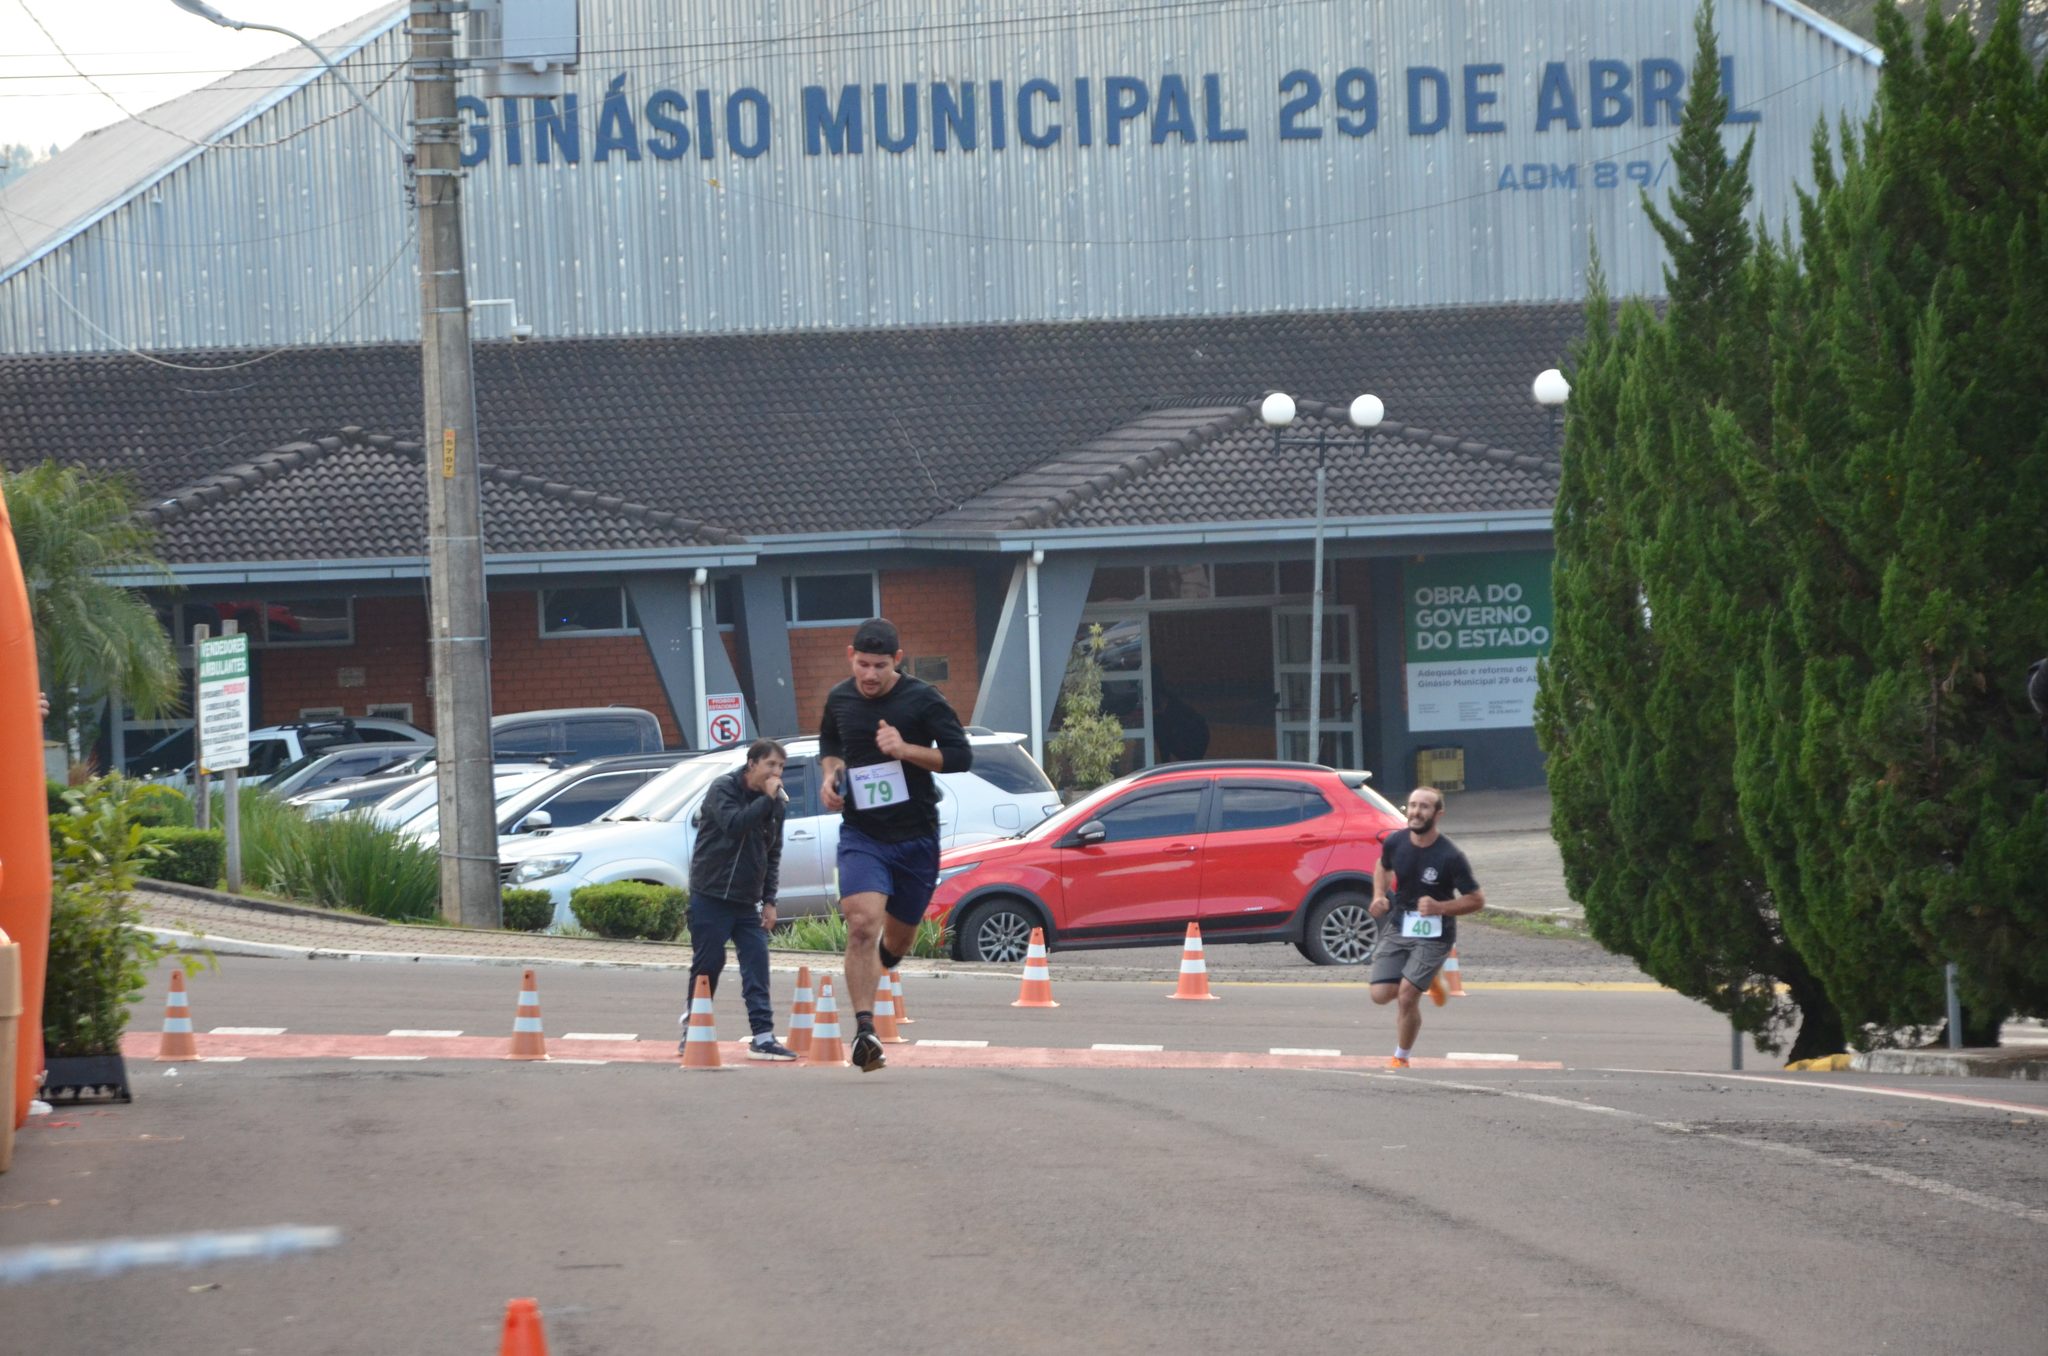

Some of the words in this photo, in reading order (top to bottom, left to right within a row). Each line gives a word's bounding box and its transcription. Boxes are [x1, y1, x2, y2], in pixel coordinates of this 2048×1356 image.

[457, 71, 771, 166] GINÁSIO
[803, 72, 1247, 156] MUNICIPAL
[1278, 67, 1378, 140] 29
[1406, 63, 1505, 136] DE
[1535, 55, 1762, 132] ABRL
[1415, 585, 1481, 606] OBRA
[1487, 583, 1523, 602] DO
[1416, 605, 1532, 628] GOVERNO
[202, 637, 246, 657] VENDEDORES
[1417, 630, 1451, 650] DO
[1458, 626, 1549, 648] ESTADO
[201, 657, 246, 677] AMBULANTES
[1418, 668, 1468, 678] Adequação
[1478, 667, 1514, 675] reforma
[1516, 665, 1528, 673] do
[1418, 679, 1451, 688] Ginásio
[1453, 677, 1497, 687] Municipal
[1499, 677, 1510, 685] 29
[1513, 676, 1524, 684] de
[864, 780, 893, 804] 79
[1412, 920, 1432, 935] 40
